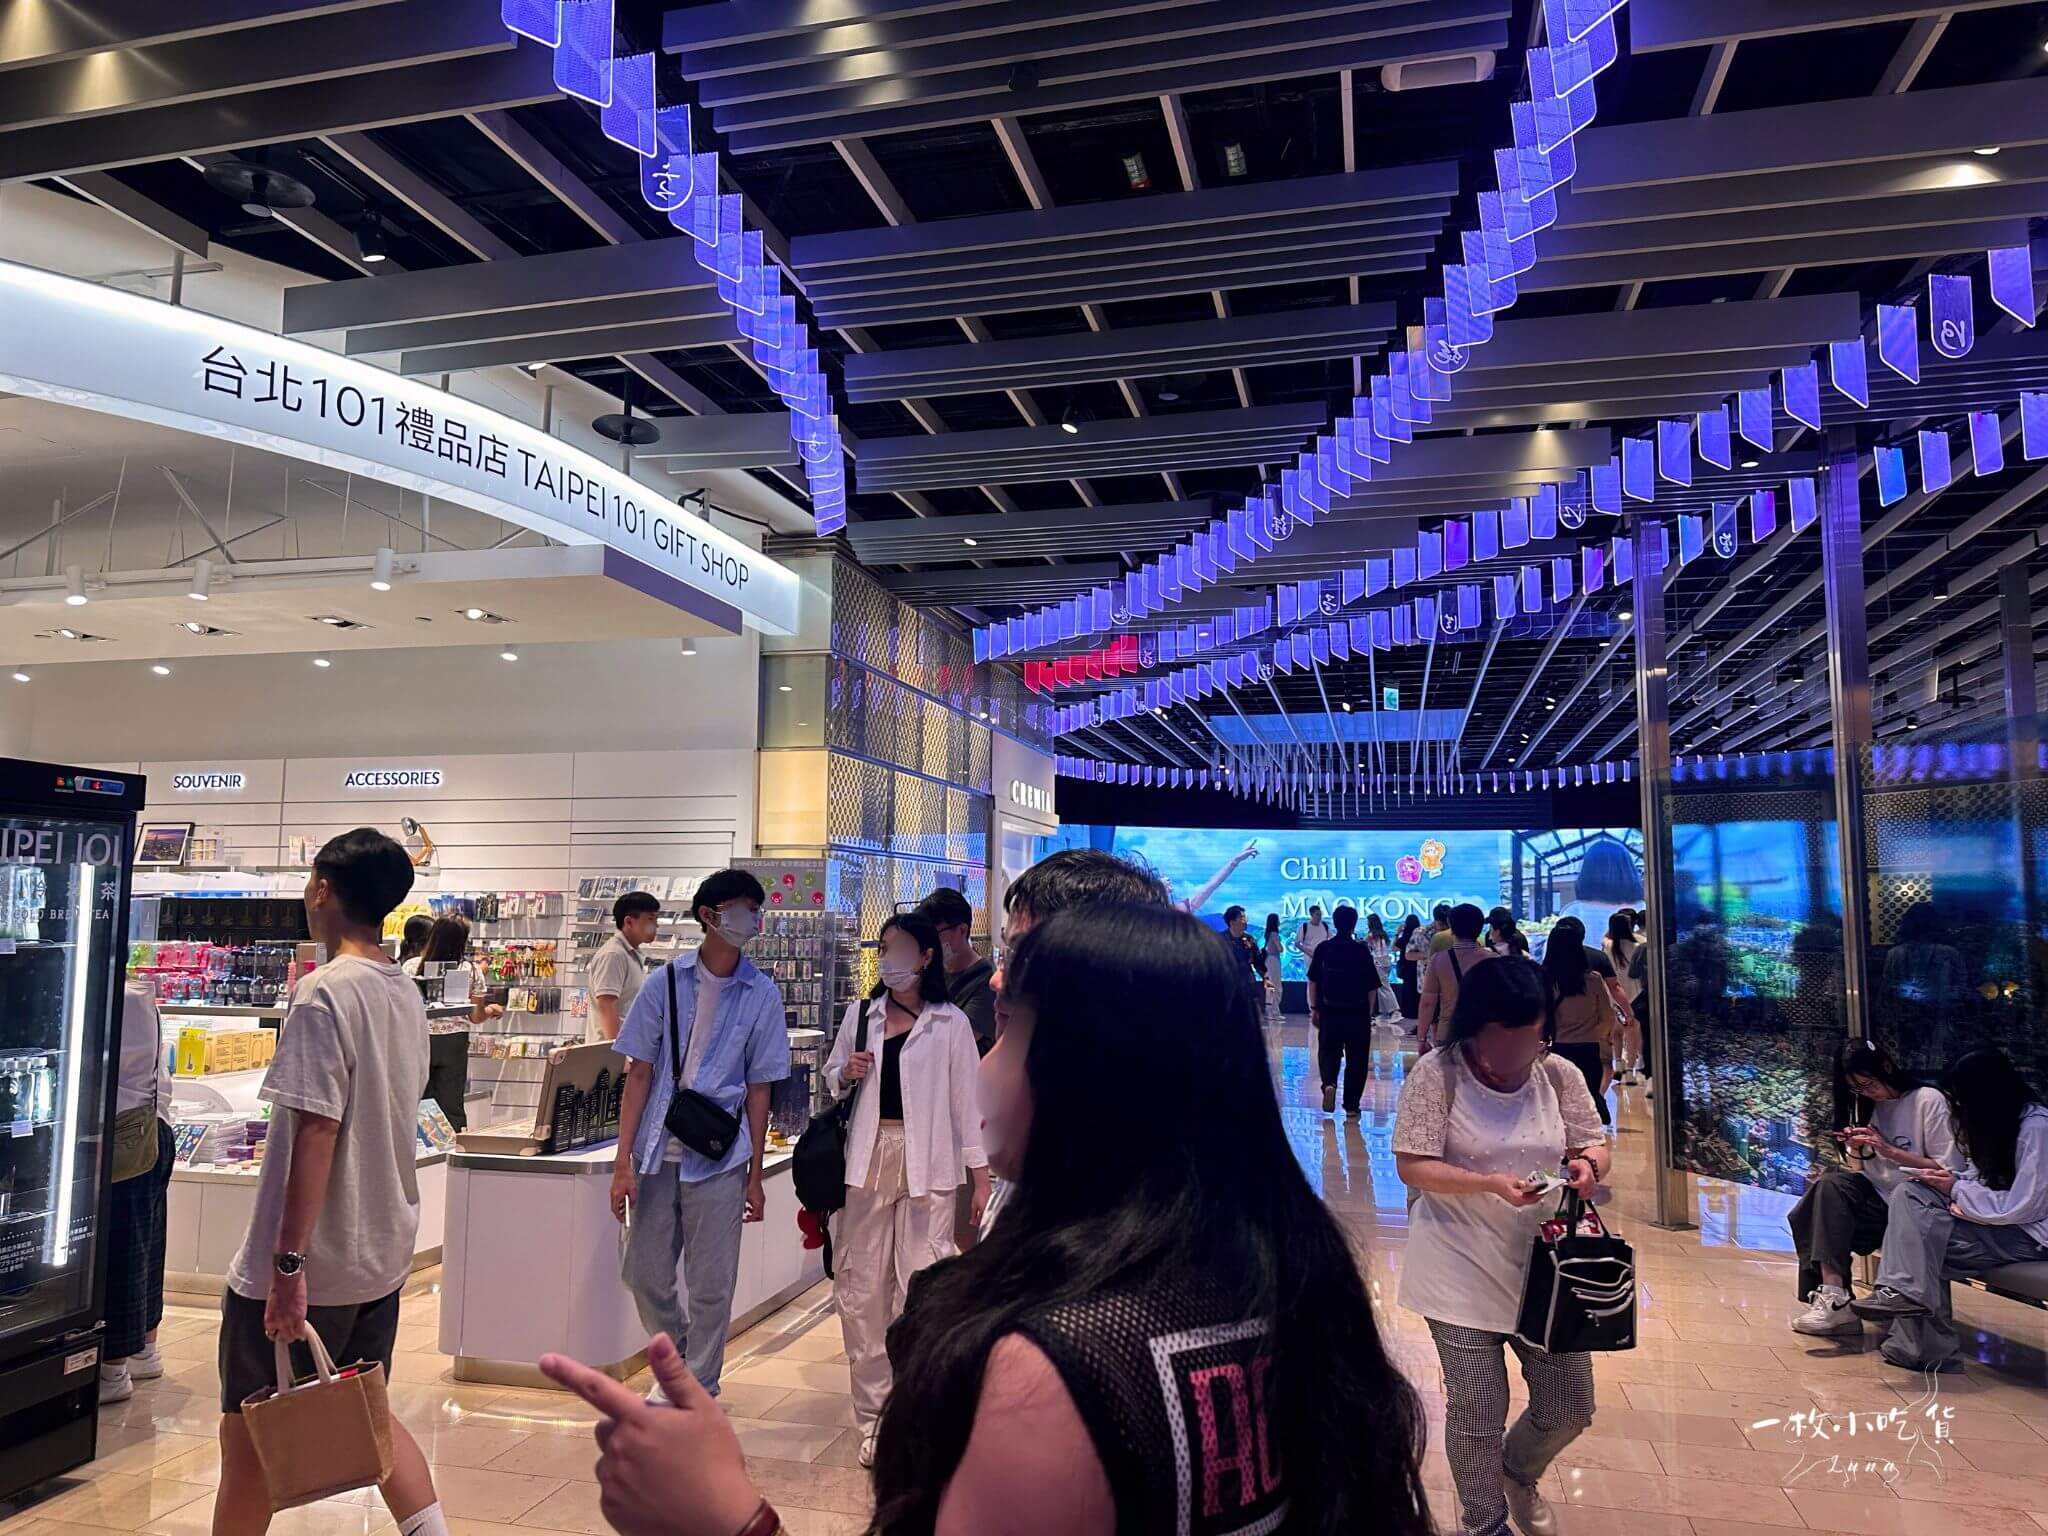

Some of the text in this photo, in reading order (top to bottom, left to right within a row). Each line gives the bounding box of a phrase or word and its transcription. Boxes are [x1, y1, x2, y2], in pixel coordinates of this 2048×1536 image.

[201, 346, 749, 590] 台北101禮品店 TAIPEI 101 GIFT SHOP
[173, 774, 242, 789] SOUVENIR
[344, 771, 441, 786] ACCESSORIES
[1011, 779, 1052, 814] CREMIA
[1280, 857, 1386, 881] Chill in
[91, 908, 110, 920] EA
